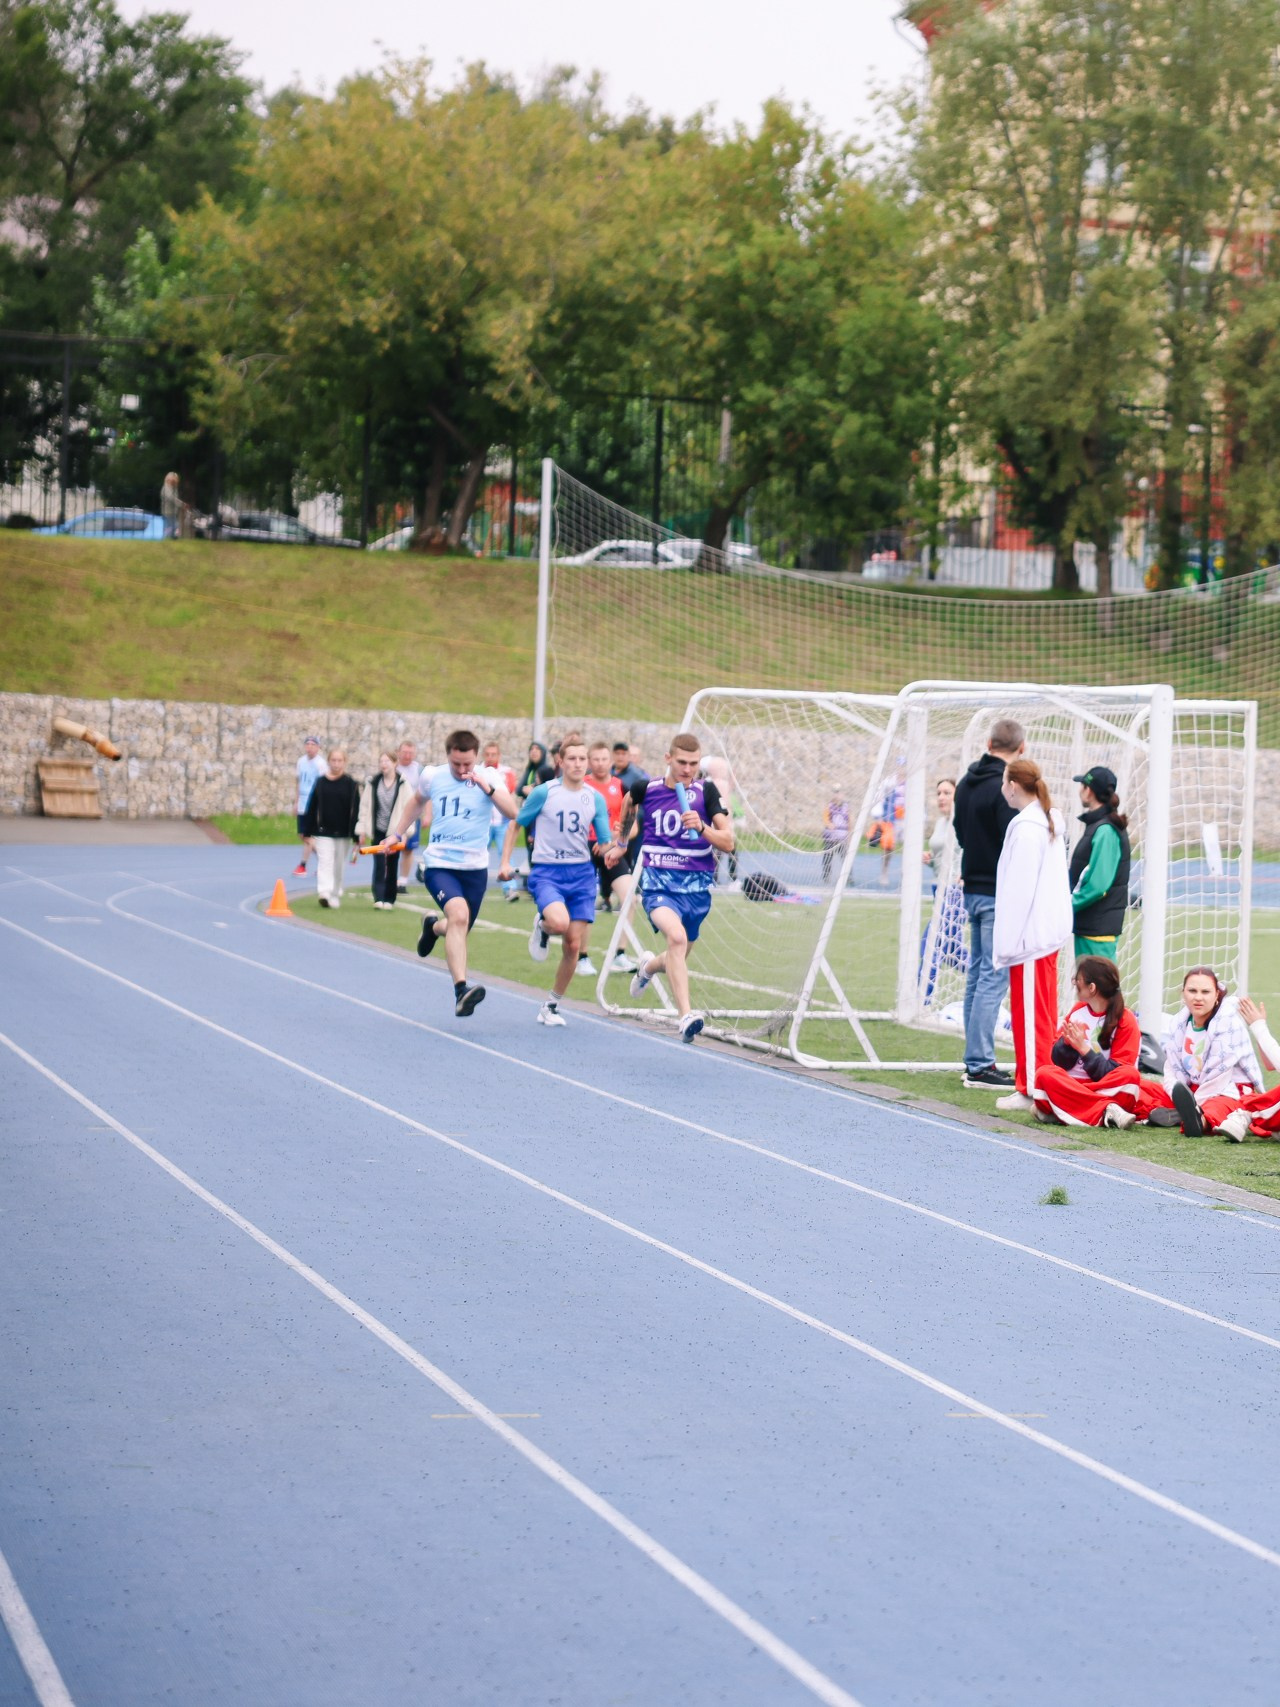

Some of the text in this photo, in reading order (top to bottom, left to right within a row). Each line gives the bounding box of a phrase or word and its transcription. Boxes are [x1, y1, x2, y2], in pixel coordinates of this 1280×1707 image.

[439, 795, 460, 817] 11
[556, 810, 580, 833] 13
[651, 809, 681, 837] 10
